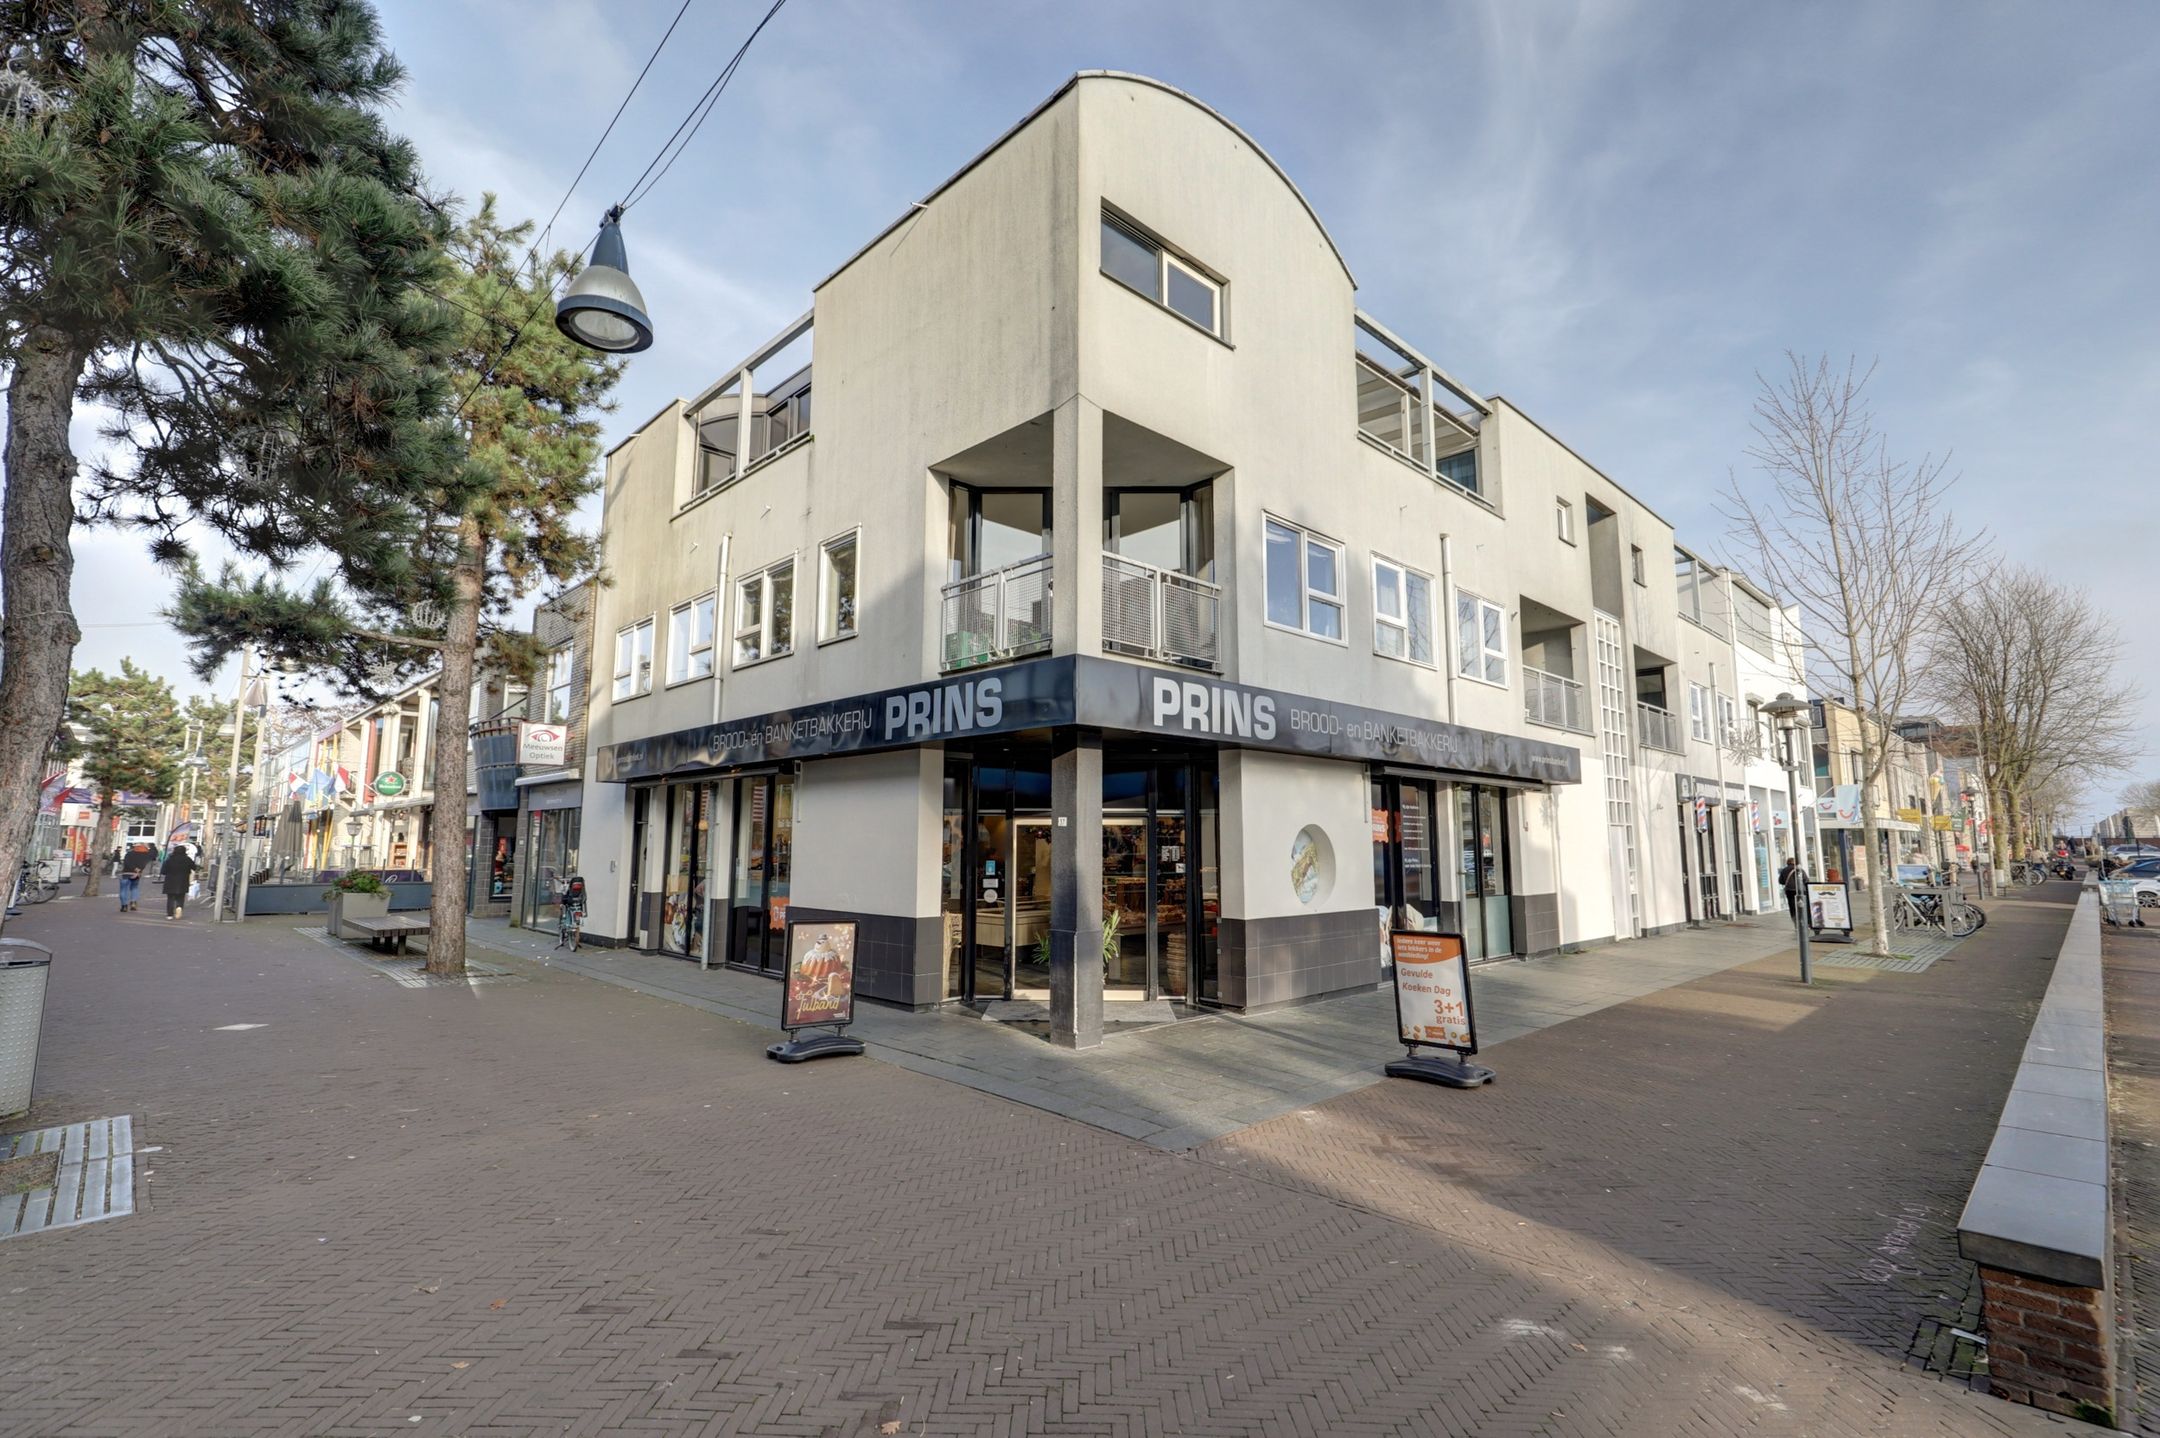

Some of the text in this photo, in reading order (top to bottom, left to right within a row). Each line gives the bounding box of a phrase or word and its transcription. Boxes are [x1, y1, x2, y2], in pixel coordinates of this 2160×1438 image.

[713, 730, 748, 752] BROOD-
[765, 708, 873, 745] BANKETBAKKERIJ
[884, 677, 1004, 741] PRINS
[1153, 676, 1458, 753] PRINS BROOD- en BANKETBAKKERIJ
[523, 743, 563, 752] Meeuwsen
[529, 752, 555, 760] Optiek
[1401, 968, 1433, 979] Gevulde
[1402, 982, 1451, 997] Koeken Dag
[1434, 999, 1465, 1017] 3+1
[1436, 1015, 1466, 1025] gratis
